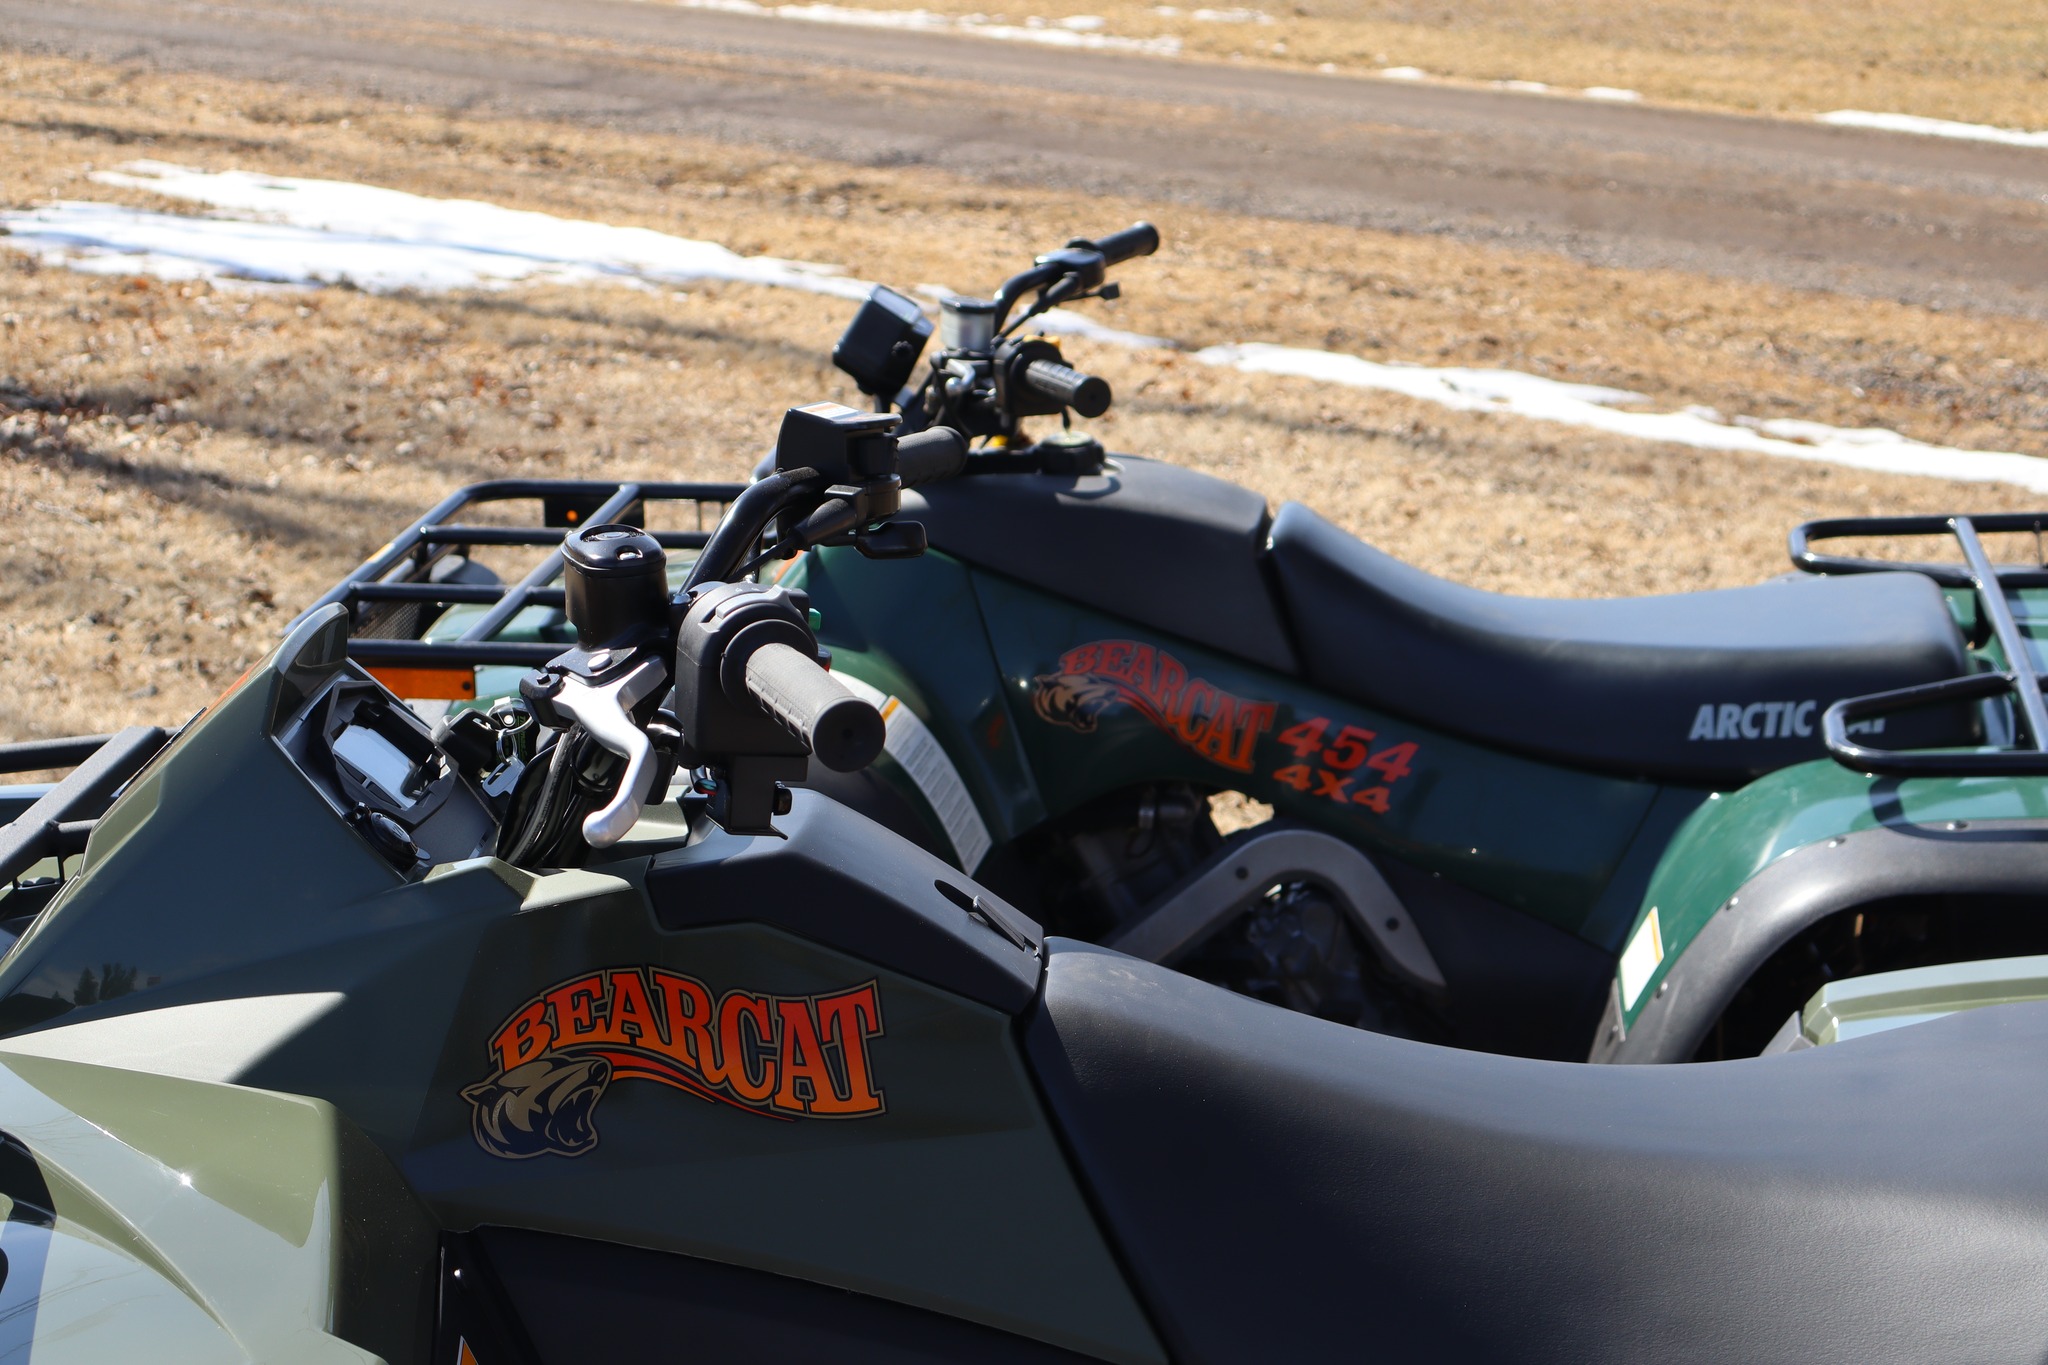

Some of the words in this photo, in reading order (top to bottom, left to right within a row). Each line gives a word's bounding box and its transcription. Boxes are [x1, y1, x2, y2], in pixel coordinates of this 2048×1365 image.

[1060, 640, 1278, 773] BEARCAT
[1277, 716, 1420, 783] 454
[1687, 700, 1818, 740] ARCTIC
[489, 966, 885, 1119] BEARCAT
